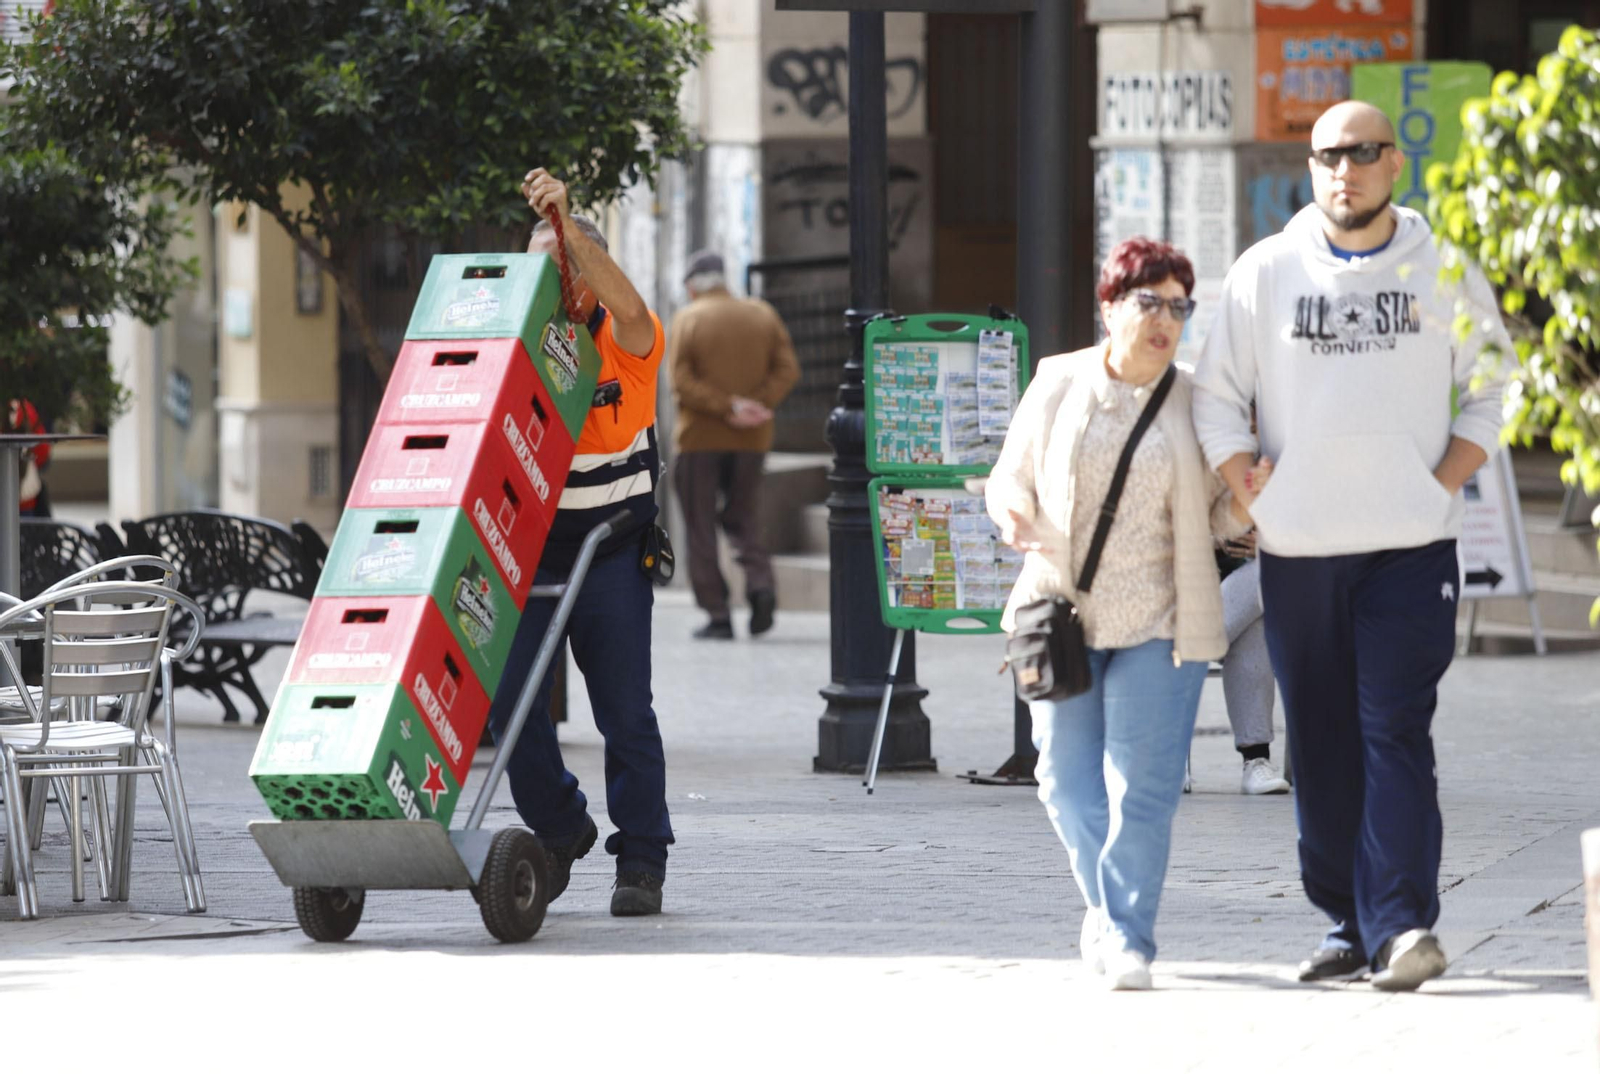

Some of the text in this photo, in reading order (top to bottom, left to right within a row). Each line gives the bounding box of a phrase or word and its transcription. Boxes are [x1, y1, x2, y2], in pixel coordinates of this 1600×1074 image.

[400, 393, 481, 408] CRUZCAMPO
[370, 477, 452, 493] CRUZCAMPO
[503, 413, 550, 505] CRUZCAMPO
[473, 498, 522, 590] CRUZCAMPO
[413, 673, 463, 765] CRUZCAMPO
